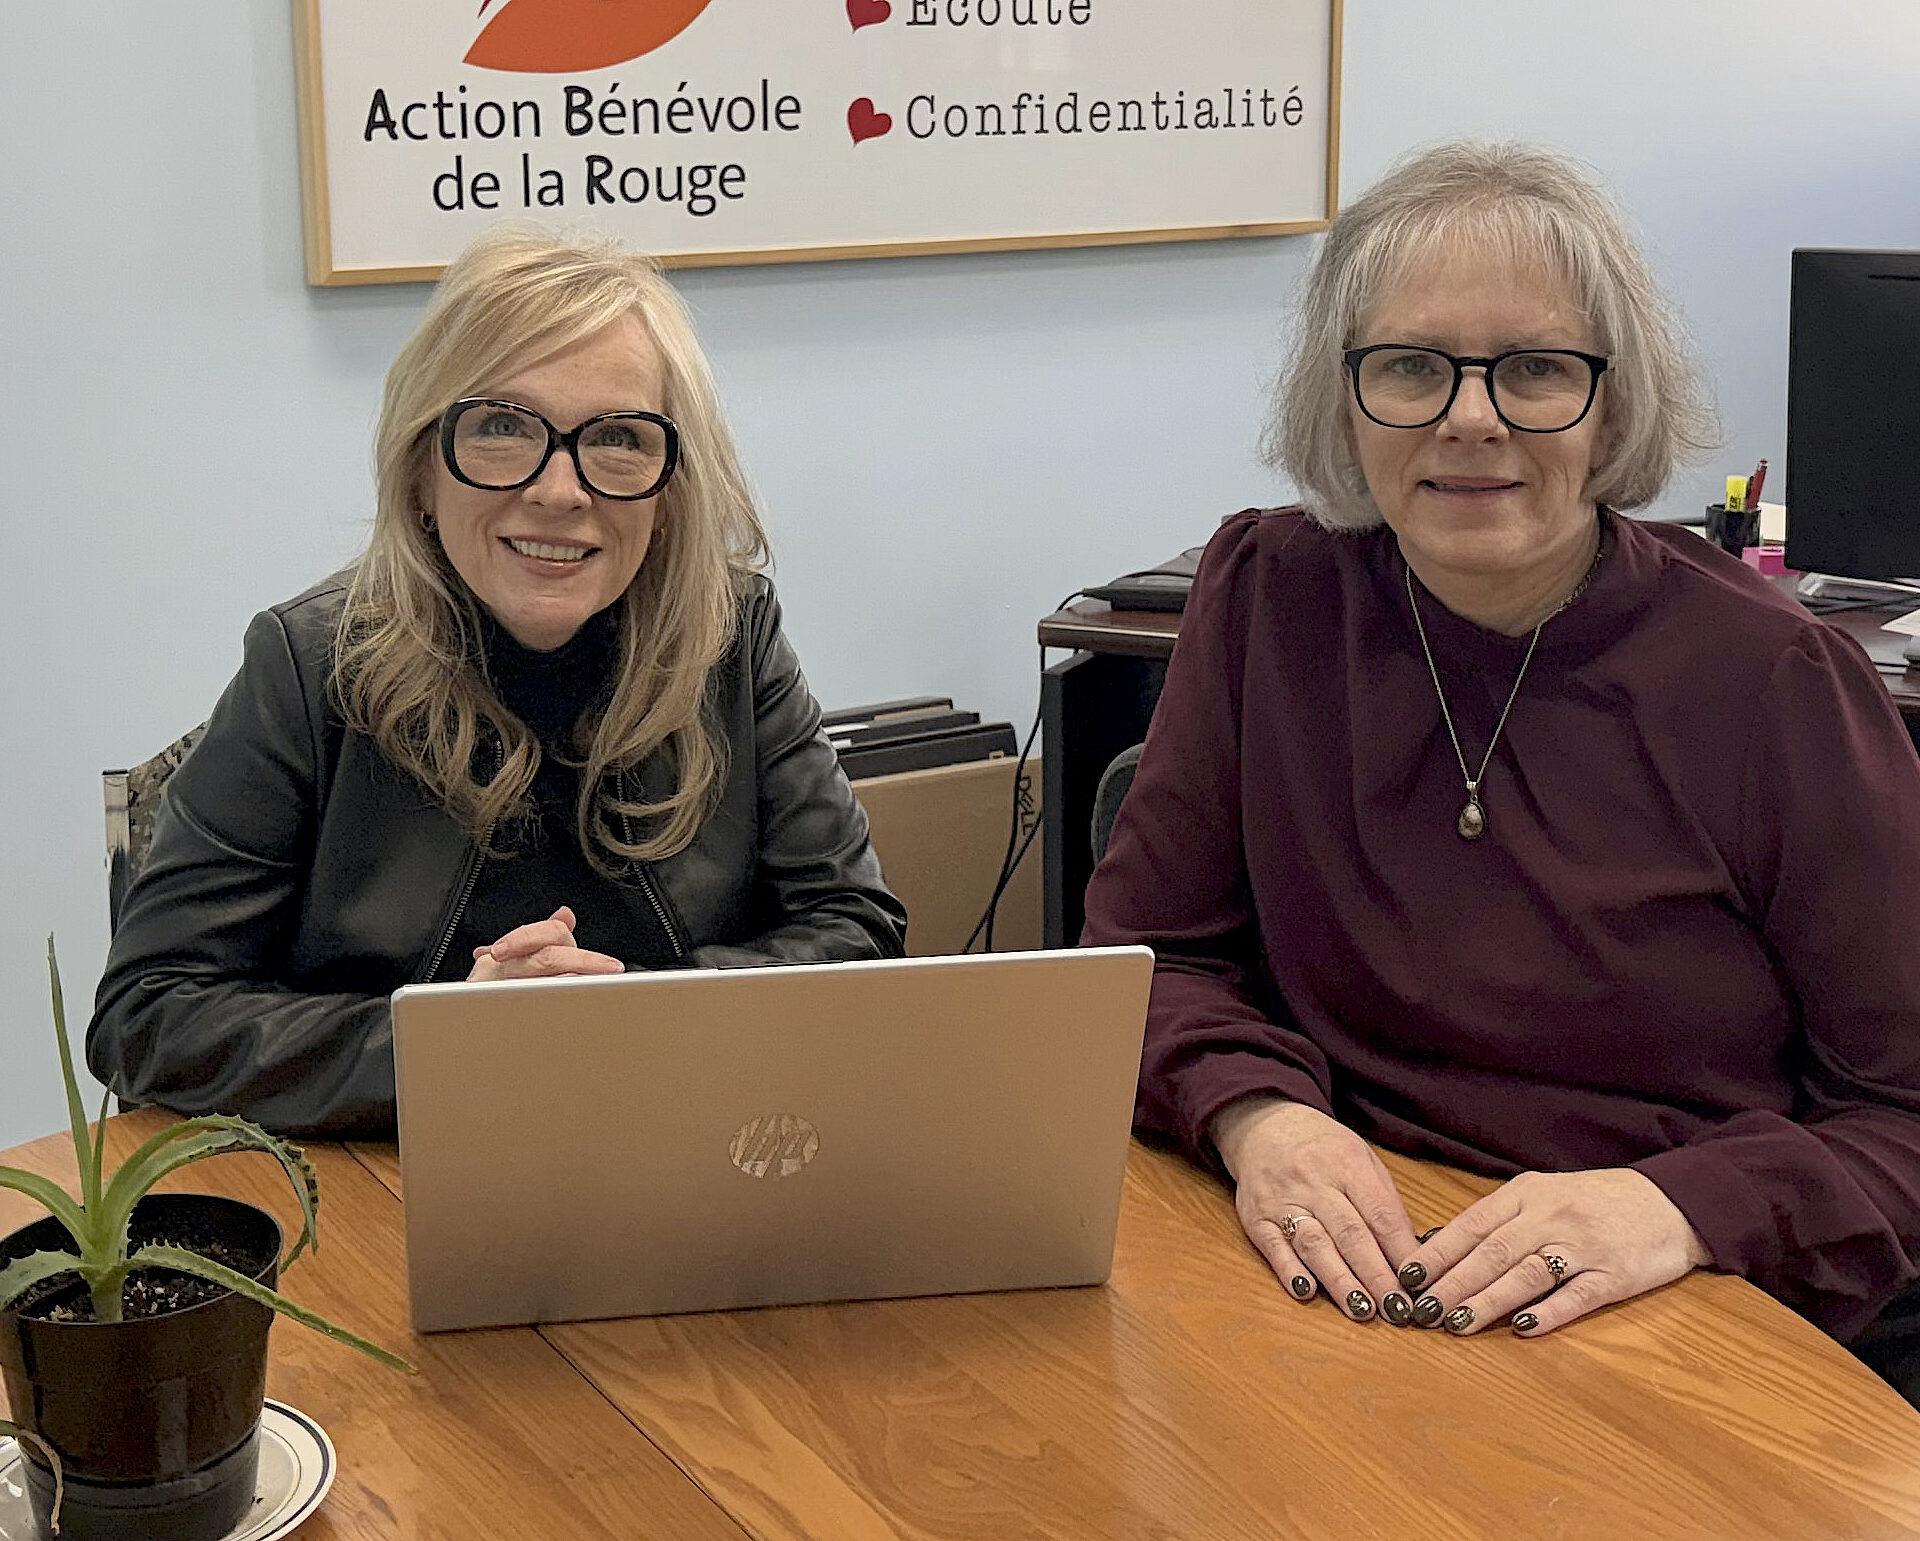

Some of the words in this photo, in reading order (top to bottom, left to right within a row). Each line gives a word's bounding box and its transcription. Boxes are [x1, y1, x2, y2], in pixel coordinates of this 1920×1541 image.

[364, 84, 541, 142] Action
[563, 79, 801, 137] Bénévole
[906, 85, 1303, 139] Confidentialité
[433, 154, 501, 211] de
[522, 152, 564, 208] la
[585, 154, 746, 217] Rouge
